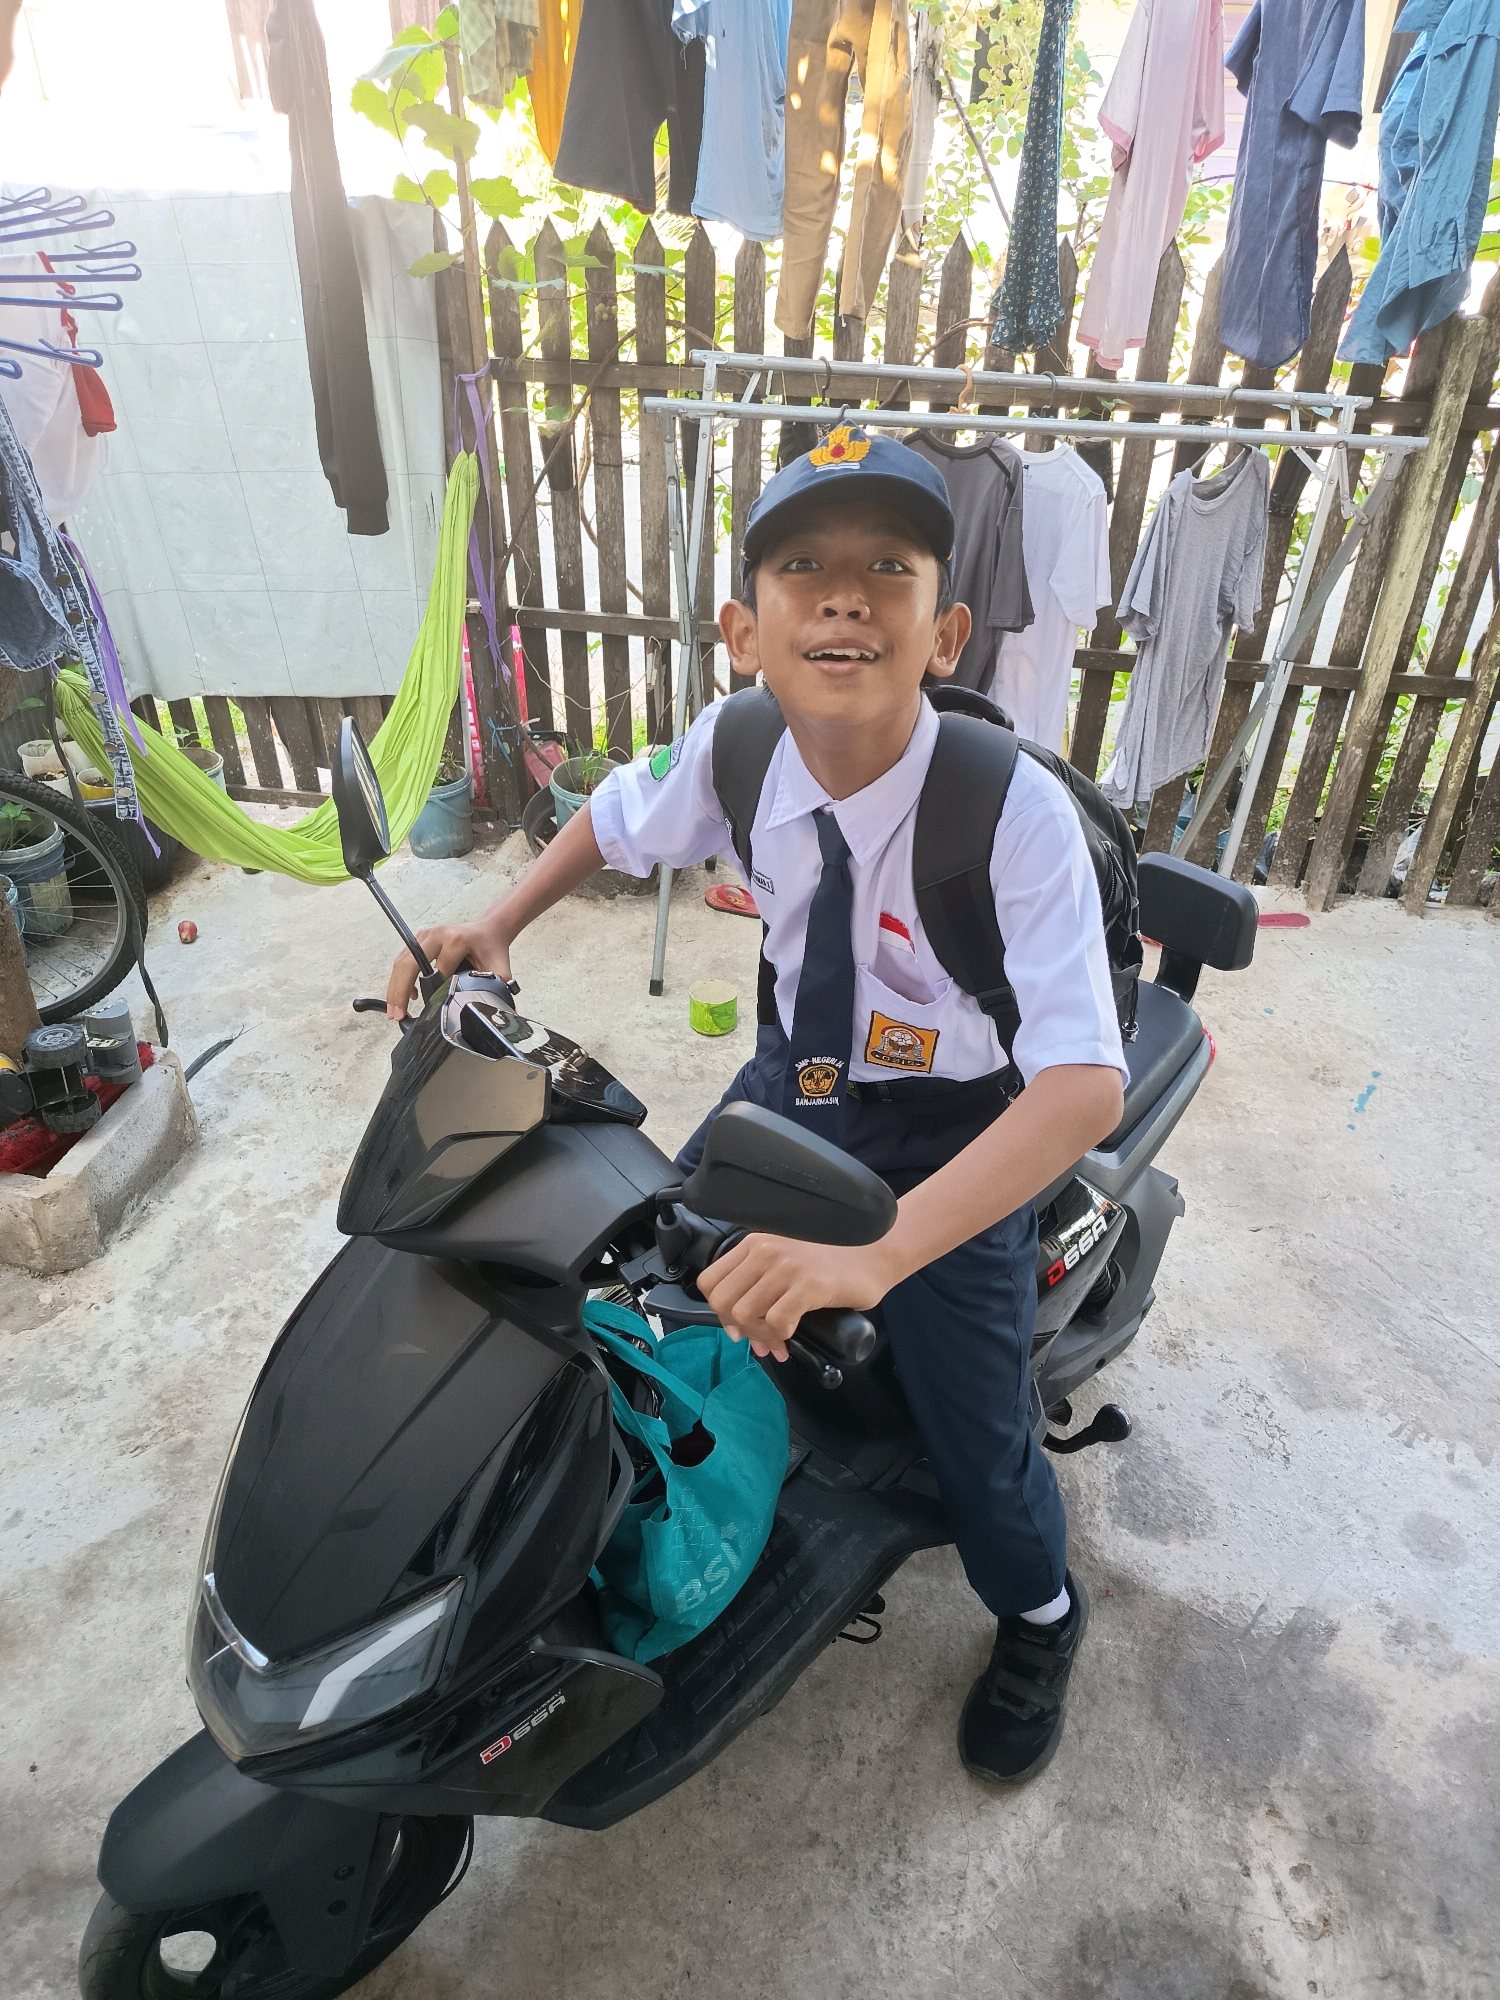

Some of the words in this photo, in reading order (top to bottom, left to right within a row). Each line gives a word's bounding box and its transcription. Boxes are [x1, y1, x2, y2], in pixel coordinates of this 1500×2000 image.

[795, 1096, 840, 1107] BANJARMASIN
[1047, 1215, 1108, 1287] D66A
[675, 1542, 742, 1614] BSI
[480, 1695, 566, 1765] D66A
